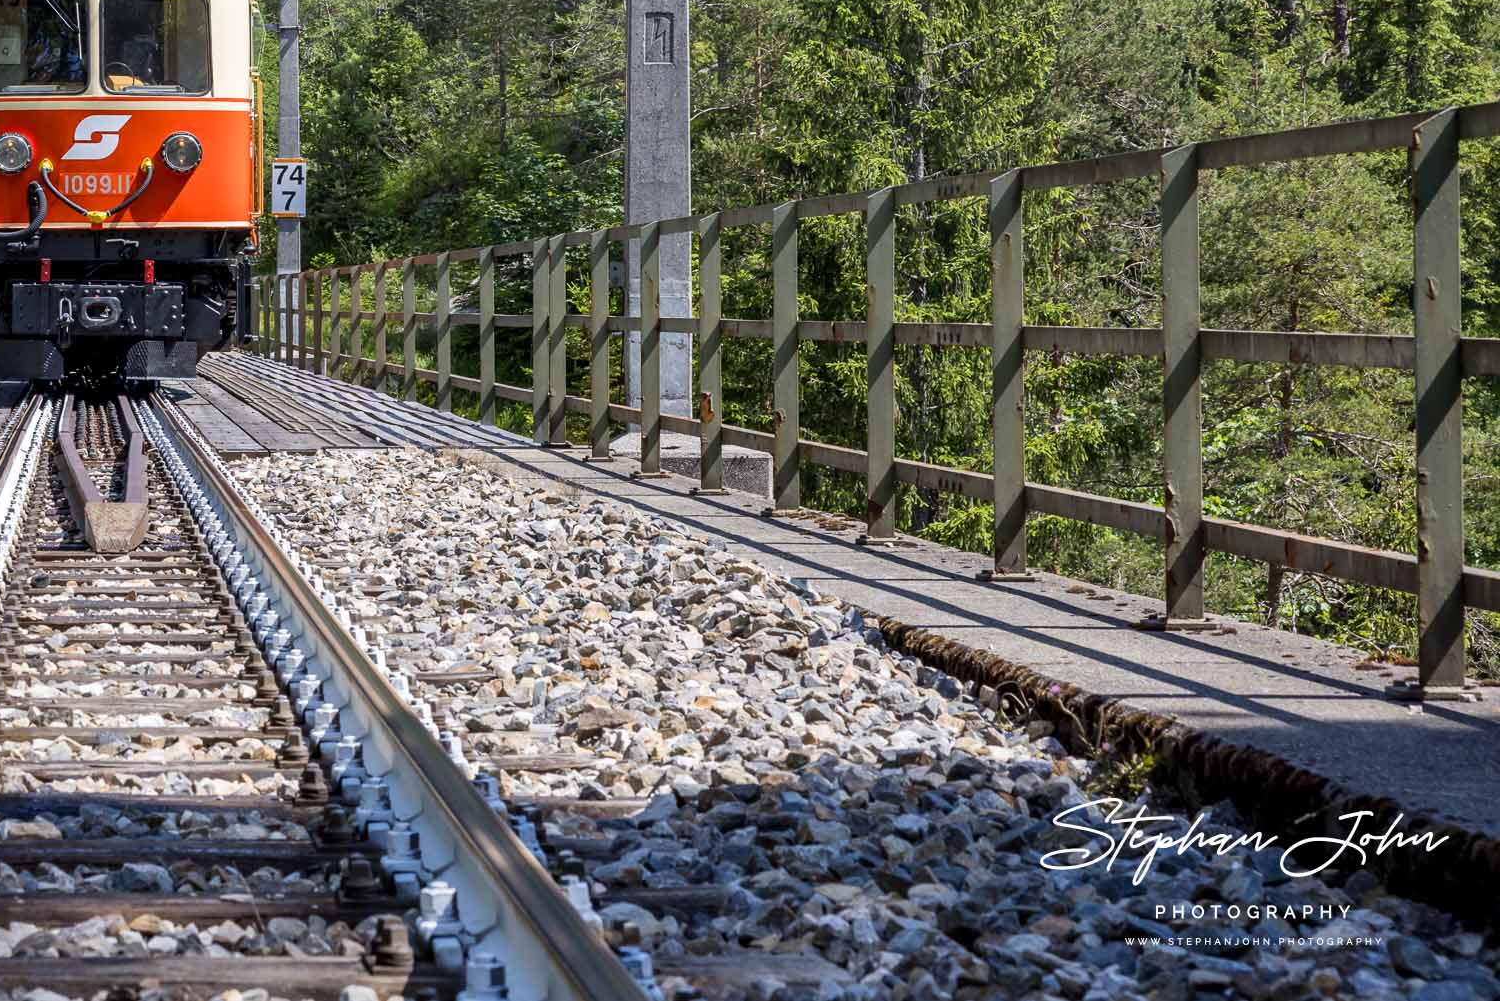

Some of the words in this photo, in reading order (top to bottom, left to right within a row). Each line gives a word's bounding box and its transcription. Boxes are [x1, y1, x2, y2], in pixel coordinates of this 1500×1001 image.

[64, 174, 131, 194] 1099.11
[274, 165, 304, 184] 74
[282, 191, 296, 211] 7
